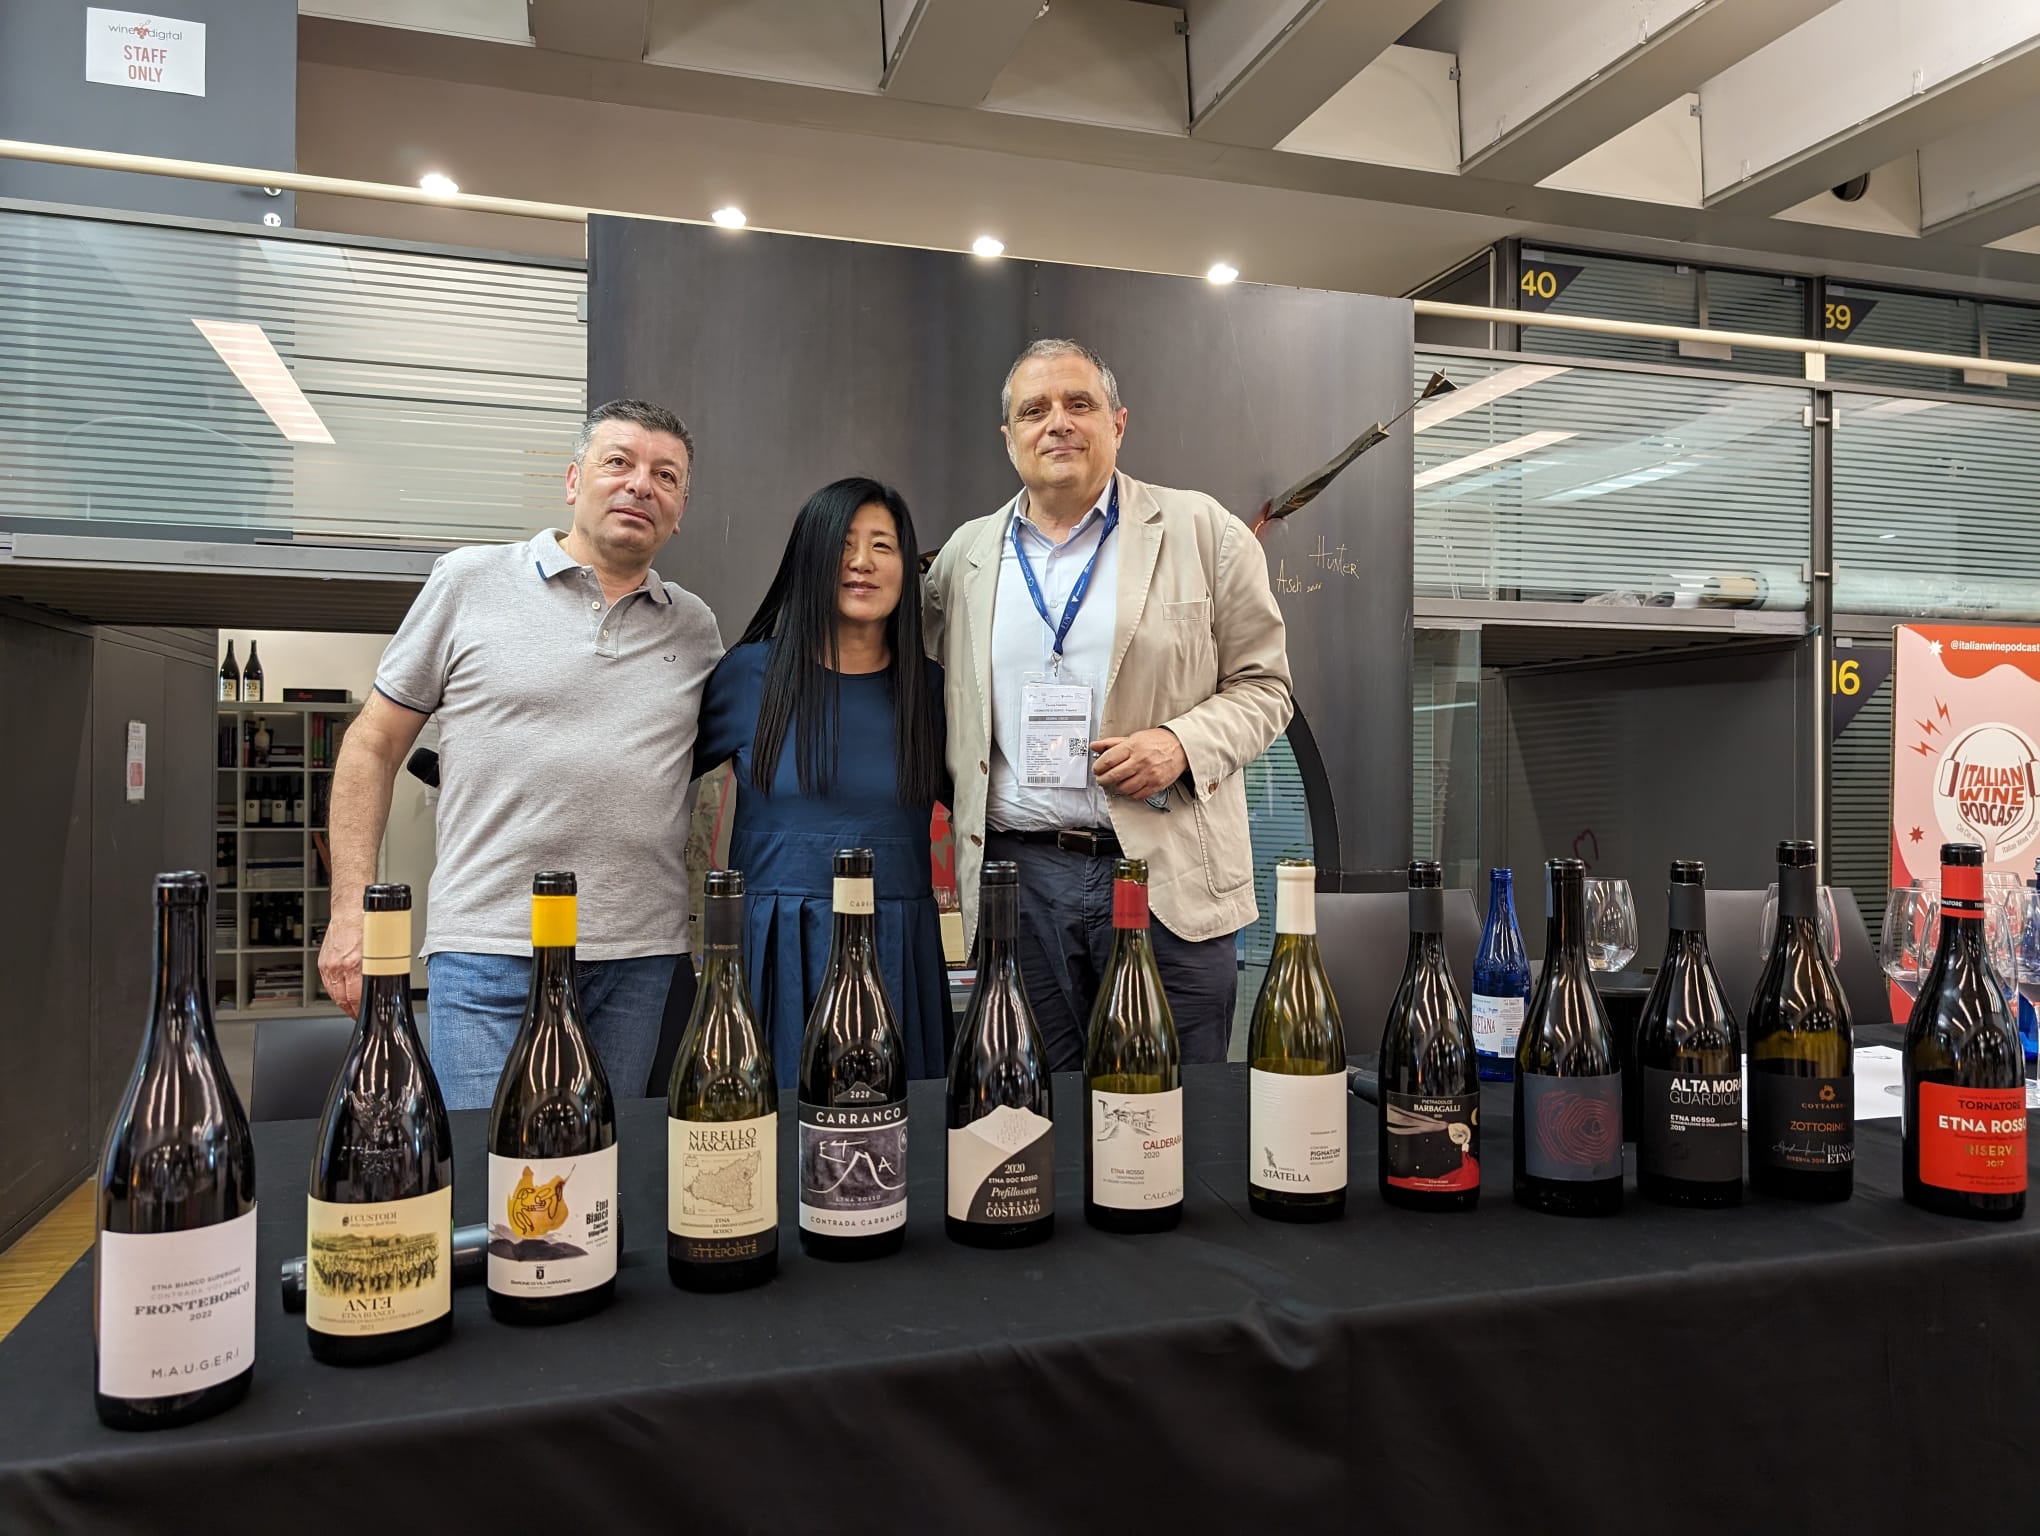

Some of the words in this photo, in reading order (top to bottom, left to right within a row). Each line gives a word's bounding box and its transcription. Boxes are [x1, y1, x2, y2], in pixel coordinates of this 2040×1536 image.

[123, 45, 168, 64] STAFF
[128, 64, 163, 82] ONLY
[1521, 270, 1557, 298] 40
[1825, 303, 1851, 330] 39
[1950, 640, 2040, 653] @italianwinepodcast
[1831, 659, 1860, 695] 16
[1960, 763, 2024, 788] ITALIAN
[1959, 786, 2025, 805] WINE
[1960, 803, 2023, 827] PODCAST
[1670, 1078, 1710, 1093] ALTA
[850, 1091, 871, 1099] 2020
[1413, 1103, 1461, 1112] BARBAGALLI
[1958, 1100, 2022, 1110] TORNATORE
[816, 1107, 901, 1125] CARRANCO
[1670, 1114, 1690, 1122] ETNA
[1938, 1115, 1987, 1133] ETNA
[689, 1128, 757, 1142] NERELLO
[688, 1138, 757, 1151] MASCALESE
[1143, 1151, 1160, 1159] 2020
[1004, 1163, 1026, 1174] 2020
[1263, 1169, 1311, 1182] STATELLA
[986, 1203, 1040, 1217] COSTANZO
[810, 1216, 856, 1226] CONTRADA
[151, 1283, 173, 1292] ETNA
[175, 1278, 205, 1289] BIANCO
[134, 1281, 250, 1316] FRONTEBOSCO
[189, 1309, 213, 1322] 2022
